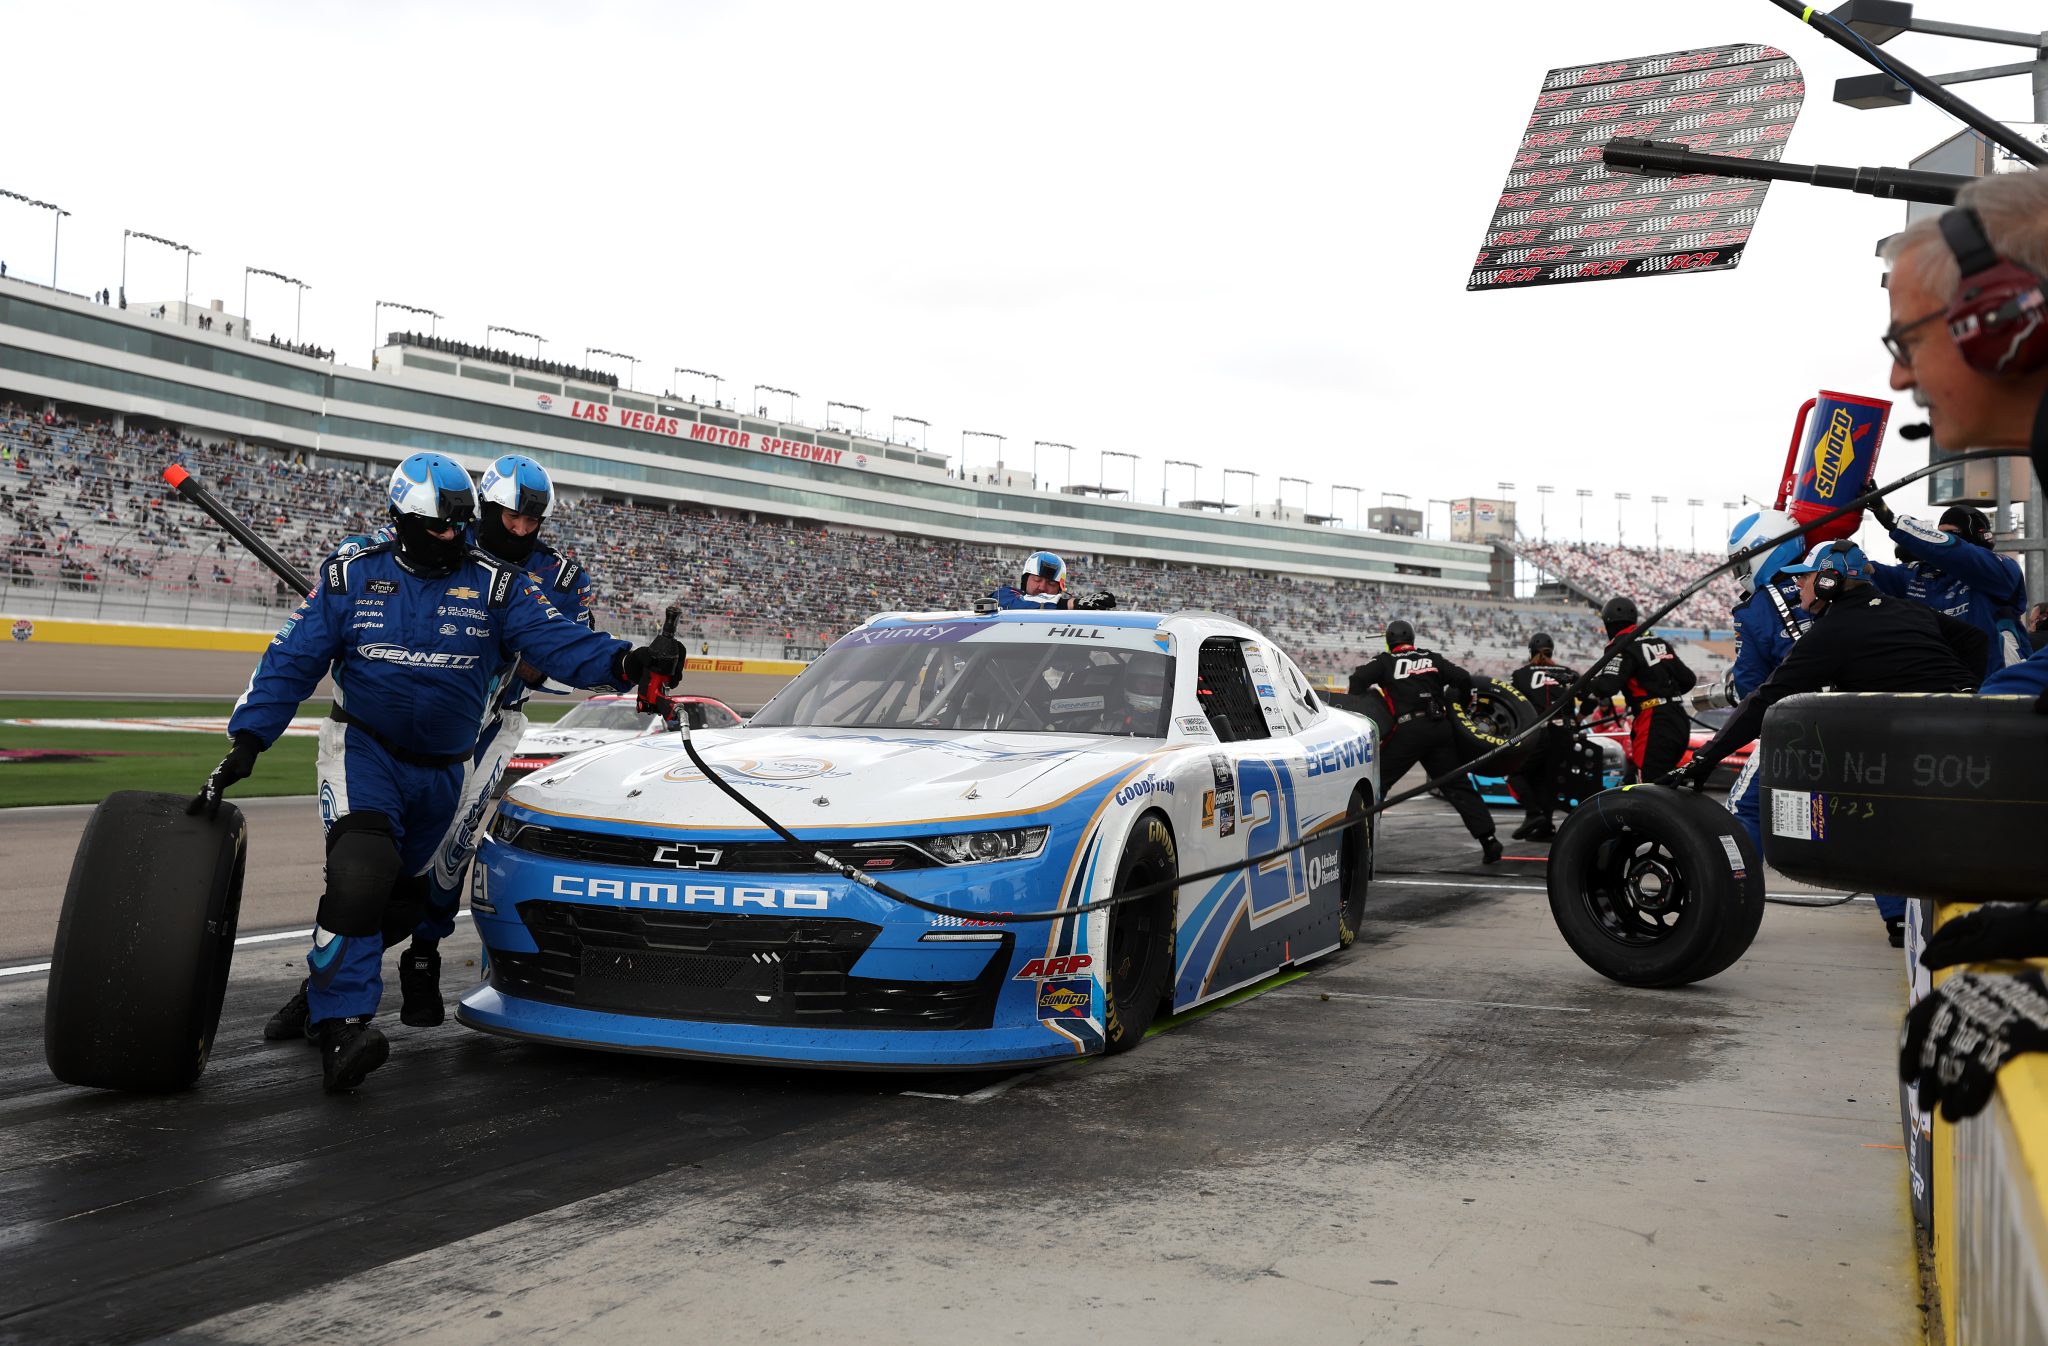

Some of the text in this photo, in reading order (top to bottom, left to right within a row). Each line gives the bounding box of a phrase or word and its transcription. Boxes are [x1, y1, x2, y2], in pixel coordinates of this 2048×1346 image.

[1666, 53, 1718, 72] RCR
[1700, 67, 1754, 88] RCR
[1610, 80, 1662, 98] RCR
[1665, 92, 1718, 112] RCR
[1700, 108, 1754, 128] RCR
[1576, 182, 1628, 201] RCR
[1699, 188, 1754, 207] RCR
[1523, 207, 1573, 225] RCR
[1664, 212, 1719, 231] RCR
[1492, 229, 1541, 247] RCR
[1576, 221, 1628, 239] RCR
[1523, 245, 1573, 263] RCR
[1665, 252, 1719, 270] RCR
[1491, 267, 1541, 284] RCR
[1577, 260, 1628, 278] RCR
[571, 401, 609, 422] LAS
[620, 409, 679, 435] VEGAS
[690, 424, 750, 449] MOTOR
[760, 437, 842, 465] SPEEDWAY
[1818, 411, 1851, 495] SUNOCO
[391, 477, 414, 504] 21
[561, 564, 578, 588] sparco
[370, 583, 395, 593] xfinity
[495, 571, 512, 602] sparco
[447, 606, 488, 617] GLOBAL
[854, 624, 958, 644] xfinity
[1047, 626, 1105, 639] HILL
[368, 648, 480, 665] BENNETT
[386, 659, 440, 669] TRANSPORTATION
[715, 659, 743, 672] PIRELLI
[1491, 678, 1528, 702] EAGLE
[1843, 751, 1887, 784] PN
[1115, 775, 1174, 806] GOODYEAR
[1237, 757, 1310, 931] 21
[1321, 850, 1337, 868] United
[474, 863, 488, 901] 21
[1321, 867, 1340, 885] Rentals
[552, 875, 828, 910] CAMARO
[1019, 954, 1093, 977] ARP
[1040, 994, 1087, 1006] SUNOCO
